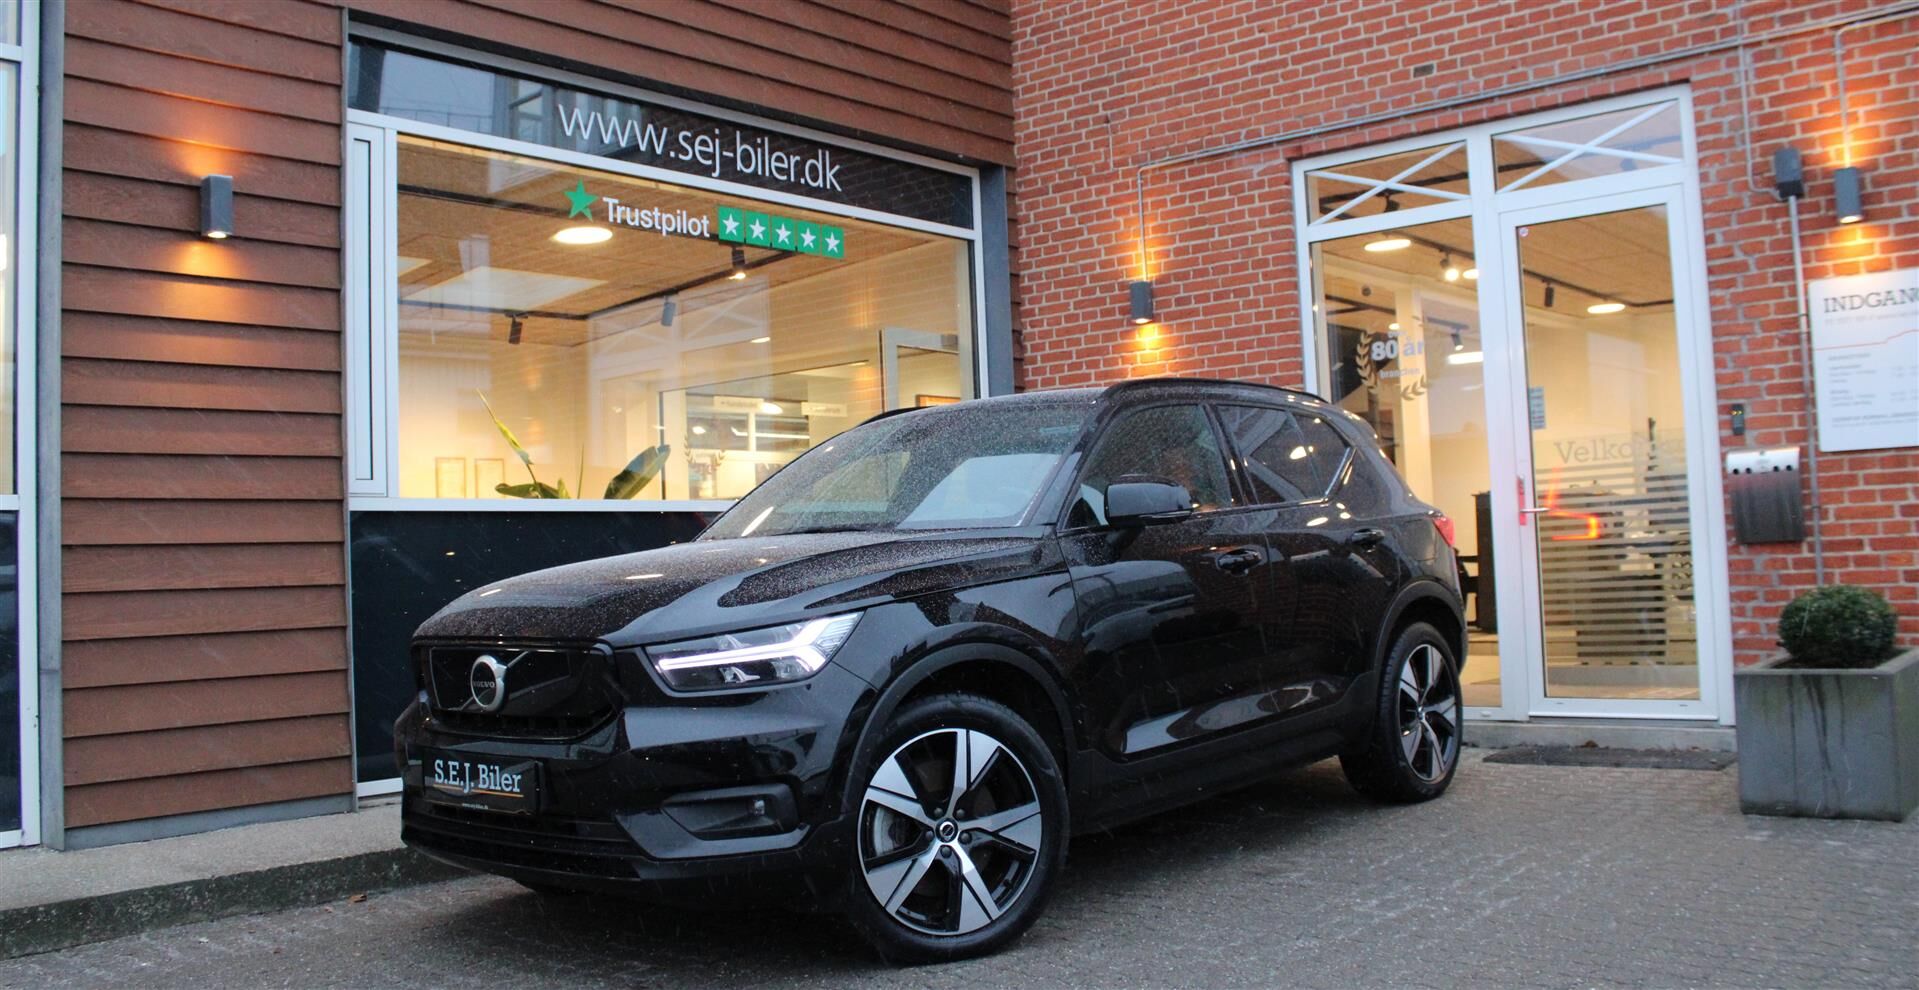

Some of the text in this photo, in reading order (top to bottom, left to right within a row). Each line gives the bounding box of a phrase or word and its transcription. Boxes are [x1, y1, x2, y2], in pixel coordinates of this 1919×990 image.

[558, 103, 842, 192] www.sej-biler.dk
[602, 196, 710, 237] Trustpilot
[1371, 340, 1398, 361] 80
[434, 759, 522, 793] S.E.J. Biler
